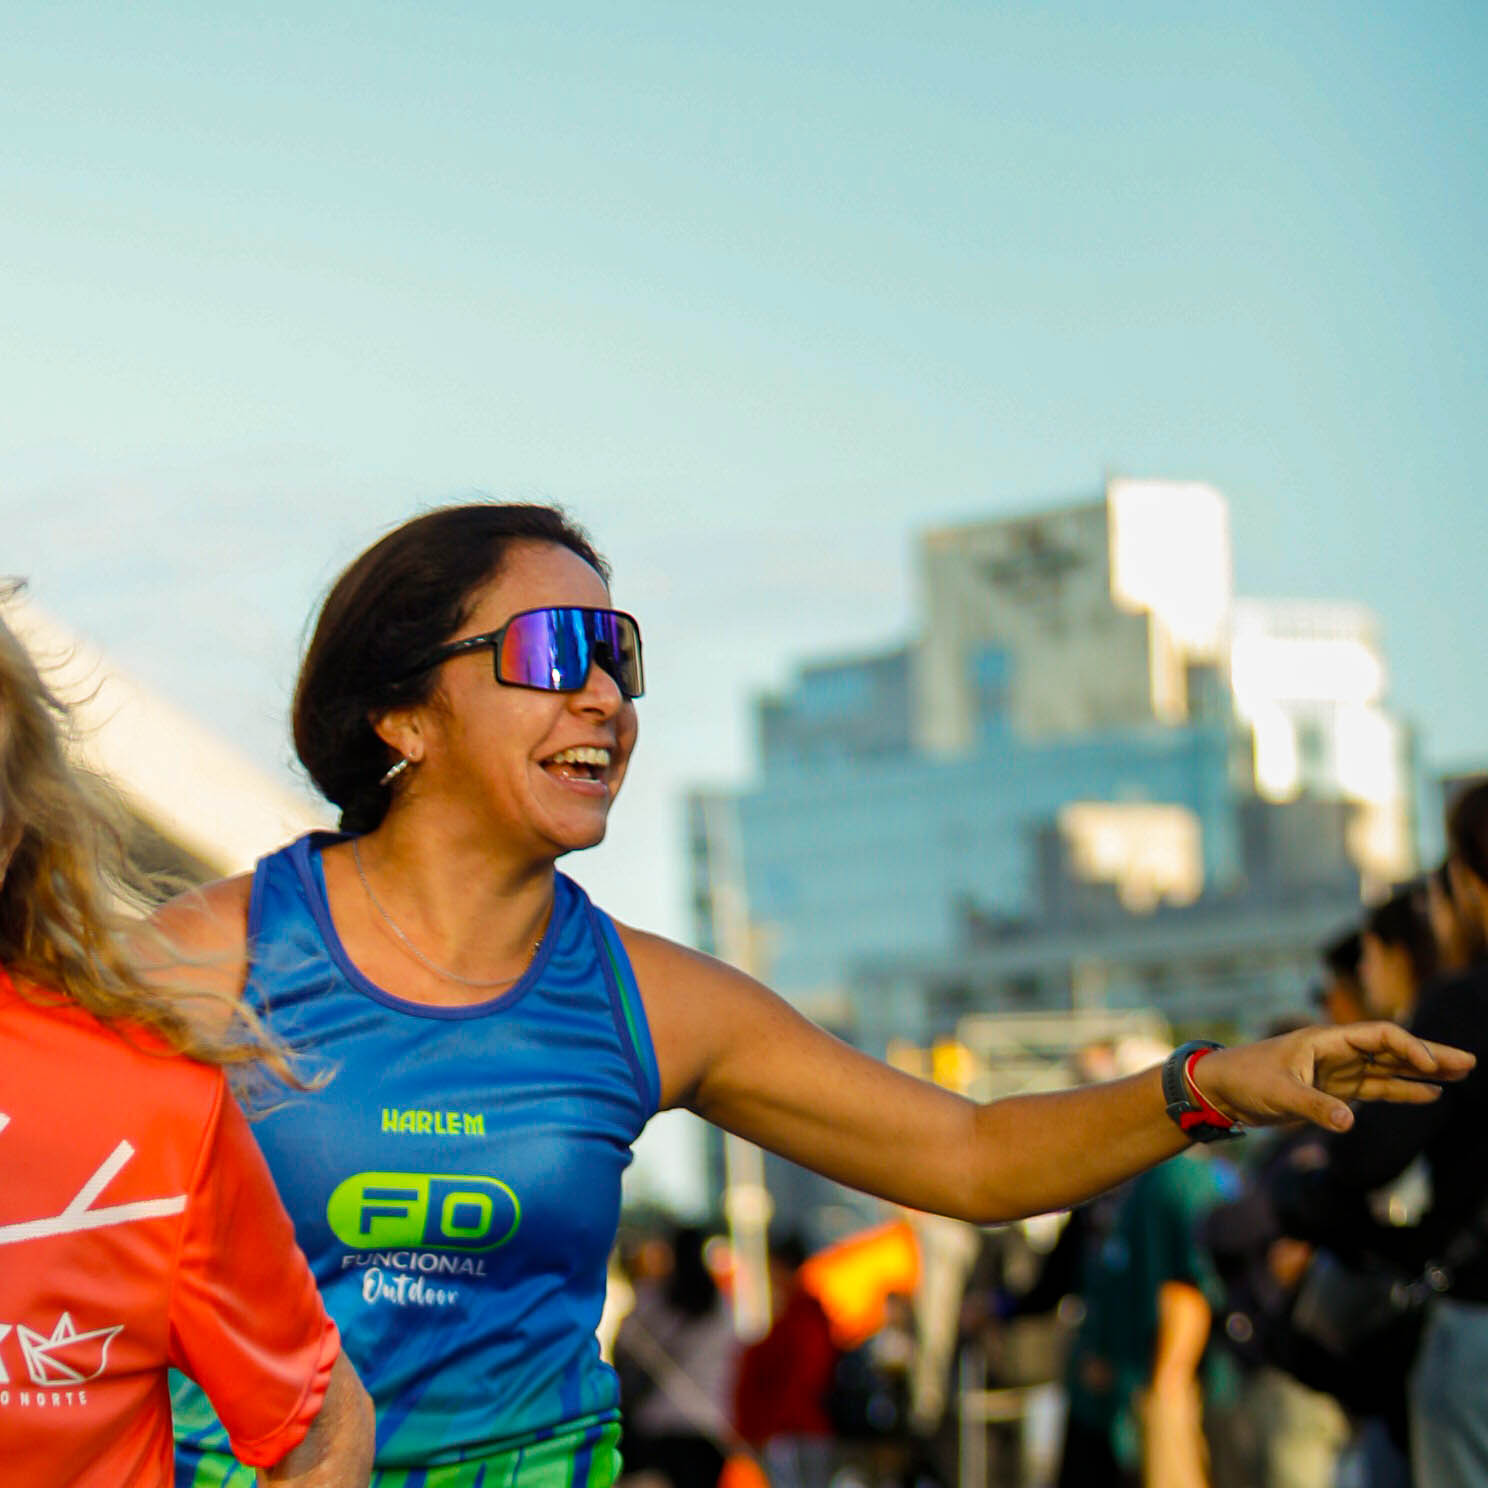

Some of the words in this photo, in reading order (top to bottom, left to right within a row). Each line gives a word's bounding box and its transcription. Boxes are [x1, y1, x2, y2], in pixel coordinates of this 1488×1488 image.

[381, 1108, 486, 1137] HARLEM
[341, 1251, 488, 1277] FUNCIONAL
[362, 1266, 460, 1307] Outdoor
[20, 1390, 88, 1407] NORTE
